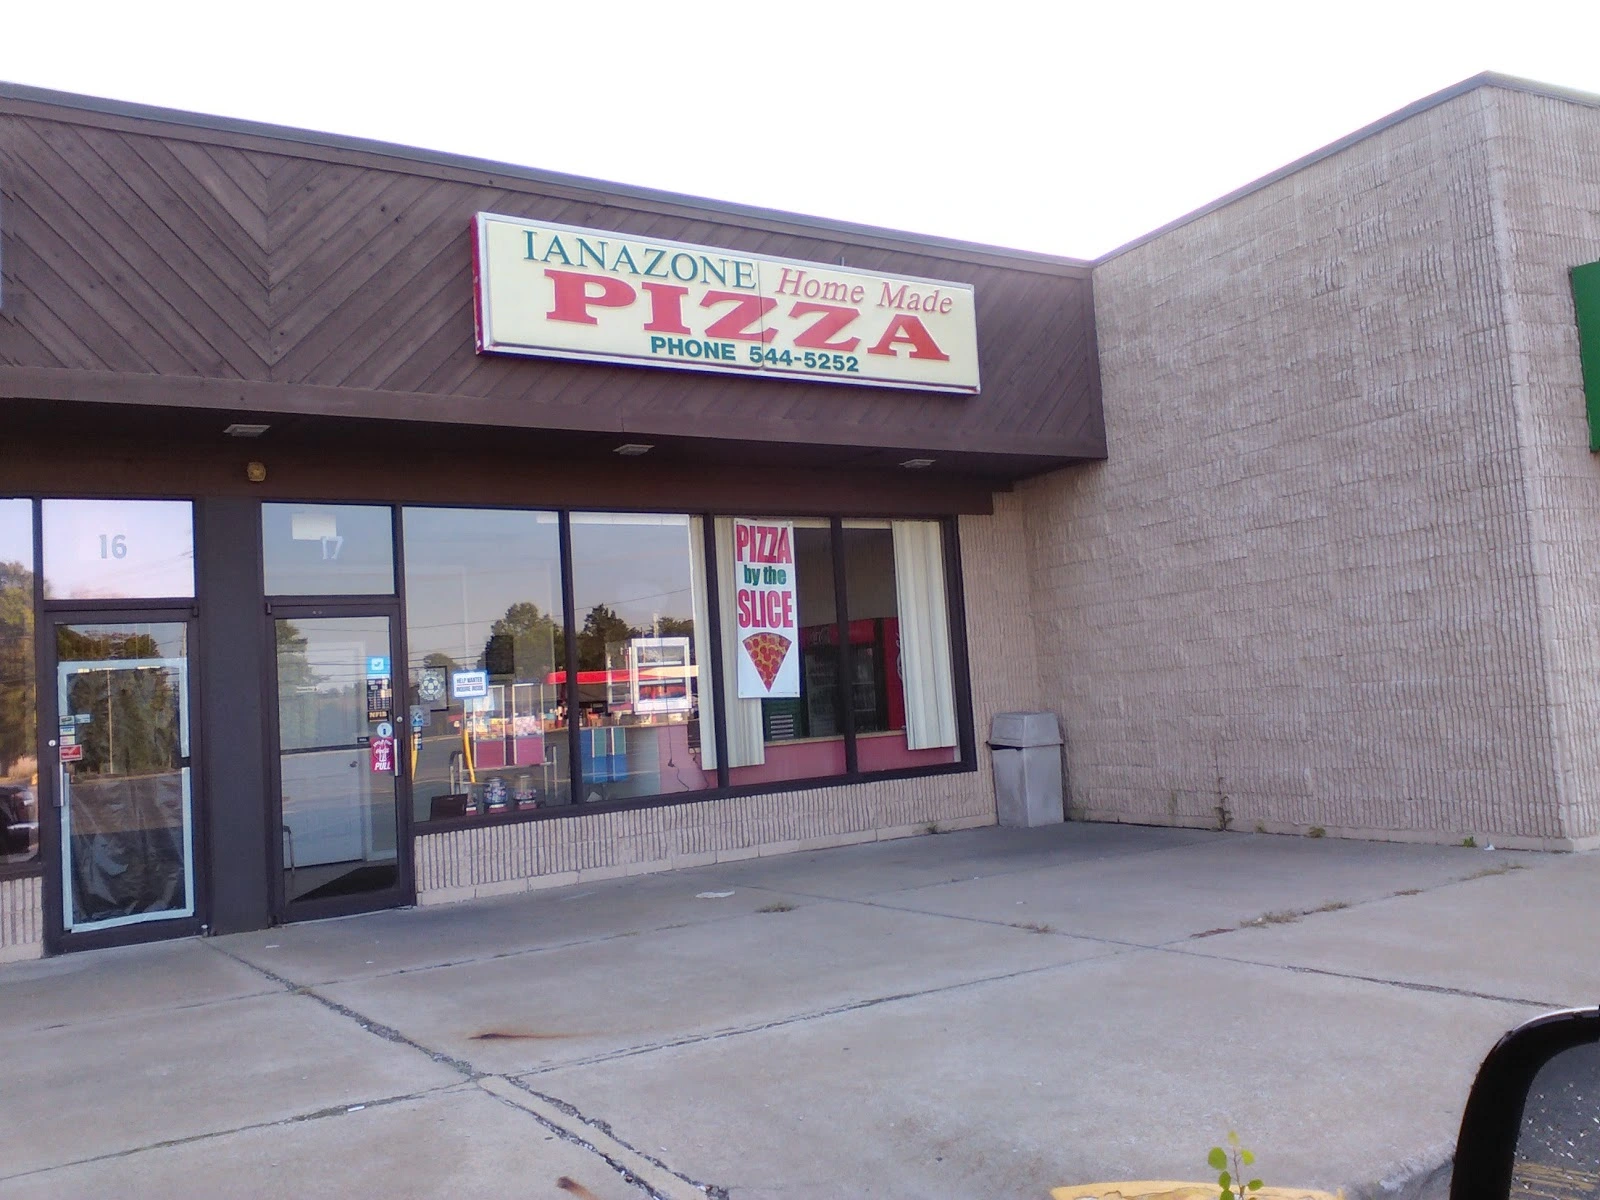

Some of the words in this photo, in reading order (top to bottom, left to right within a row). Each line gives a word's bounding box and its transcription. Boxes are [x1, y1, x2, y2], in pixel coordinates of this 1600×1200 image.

[523, 230, 756, 289] IANAZONE
[775, 267, 865, 301] Home
[876, 281, 953, 314] Made
[544, 268, 950, 362] PIZZA
[650, 336, 736, 361] PHONE
[749, 346, 859, 373] 544-5252
[99, 534, 128, 559] 16
[321, 535, 344, 560] 17
[736, 524, 792, 564] PIZZA
[743, 564, 760, 586] by
[763, 565, 787, 585] the
[737, 588, 793, 628] SLICE
[374, 761, 391, 771] PULL
